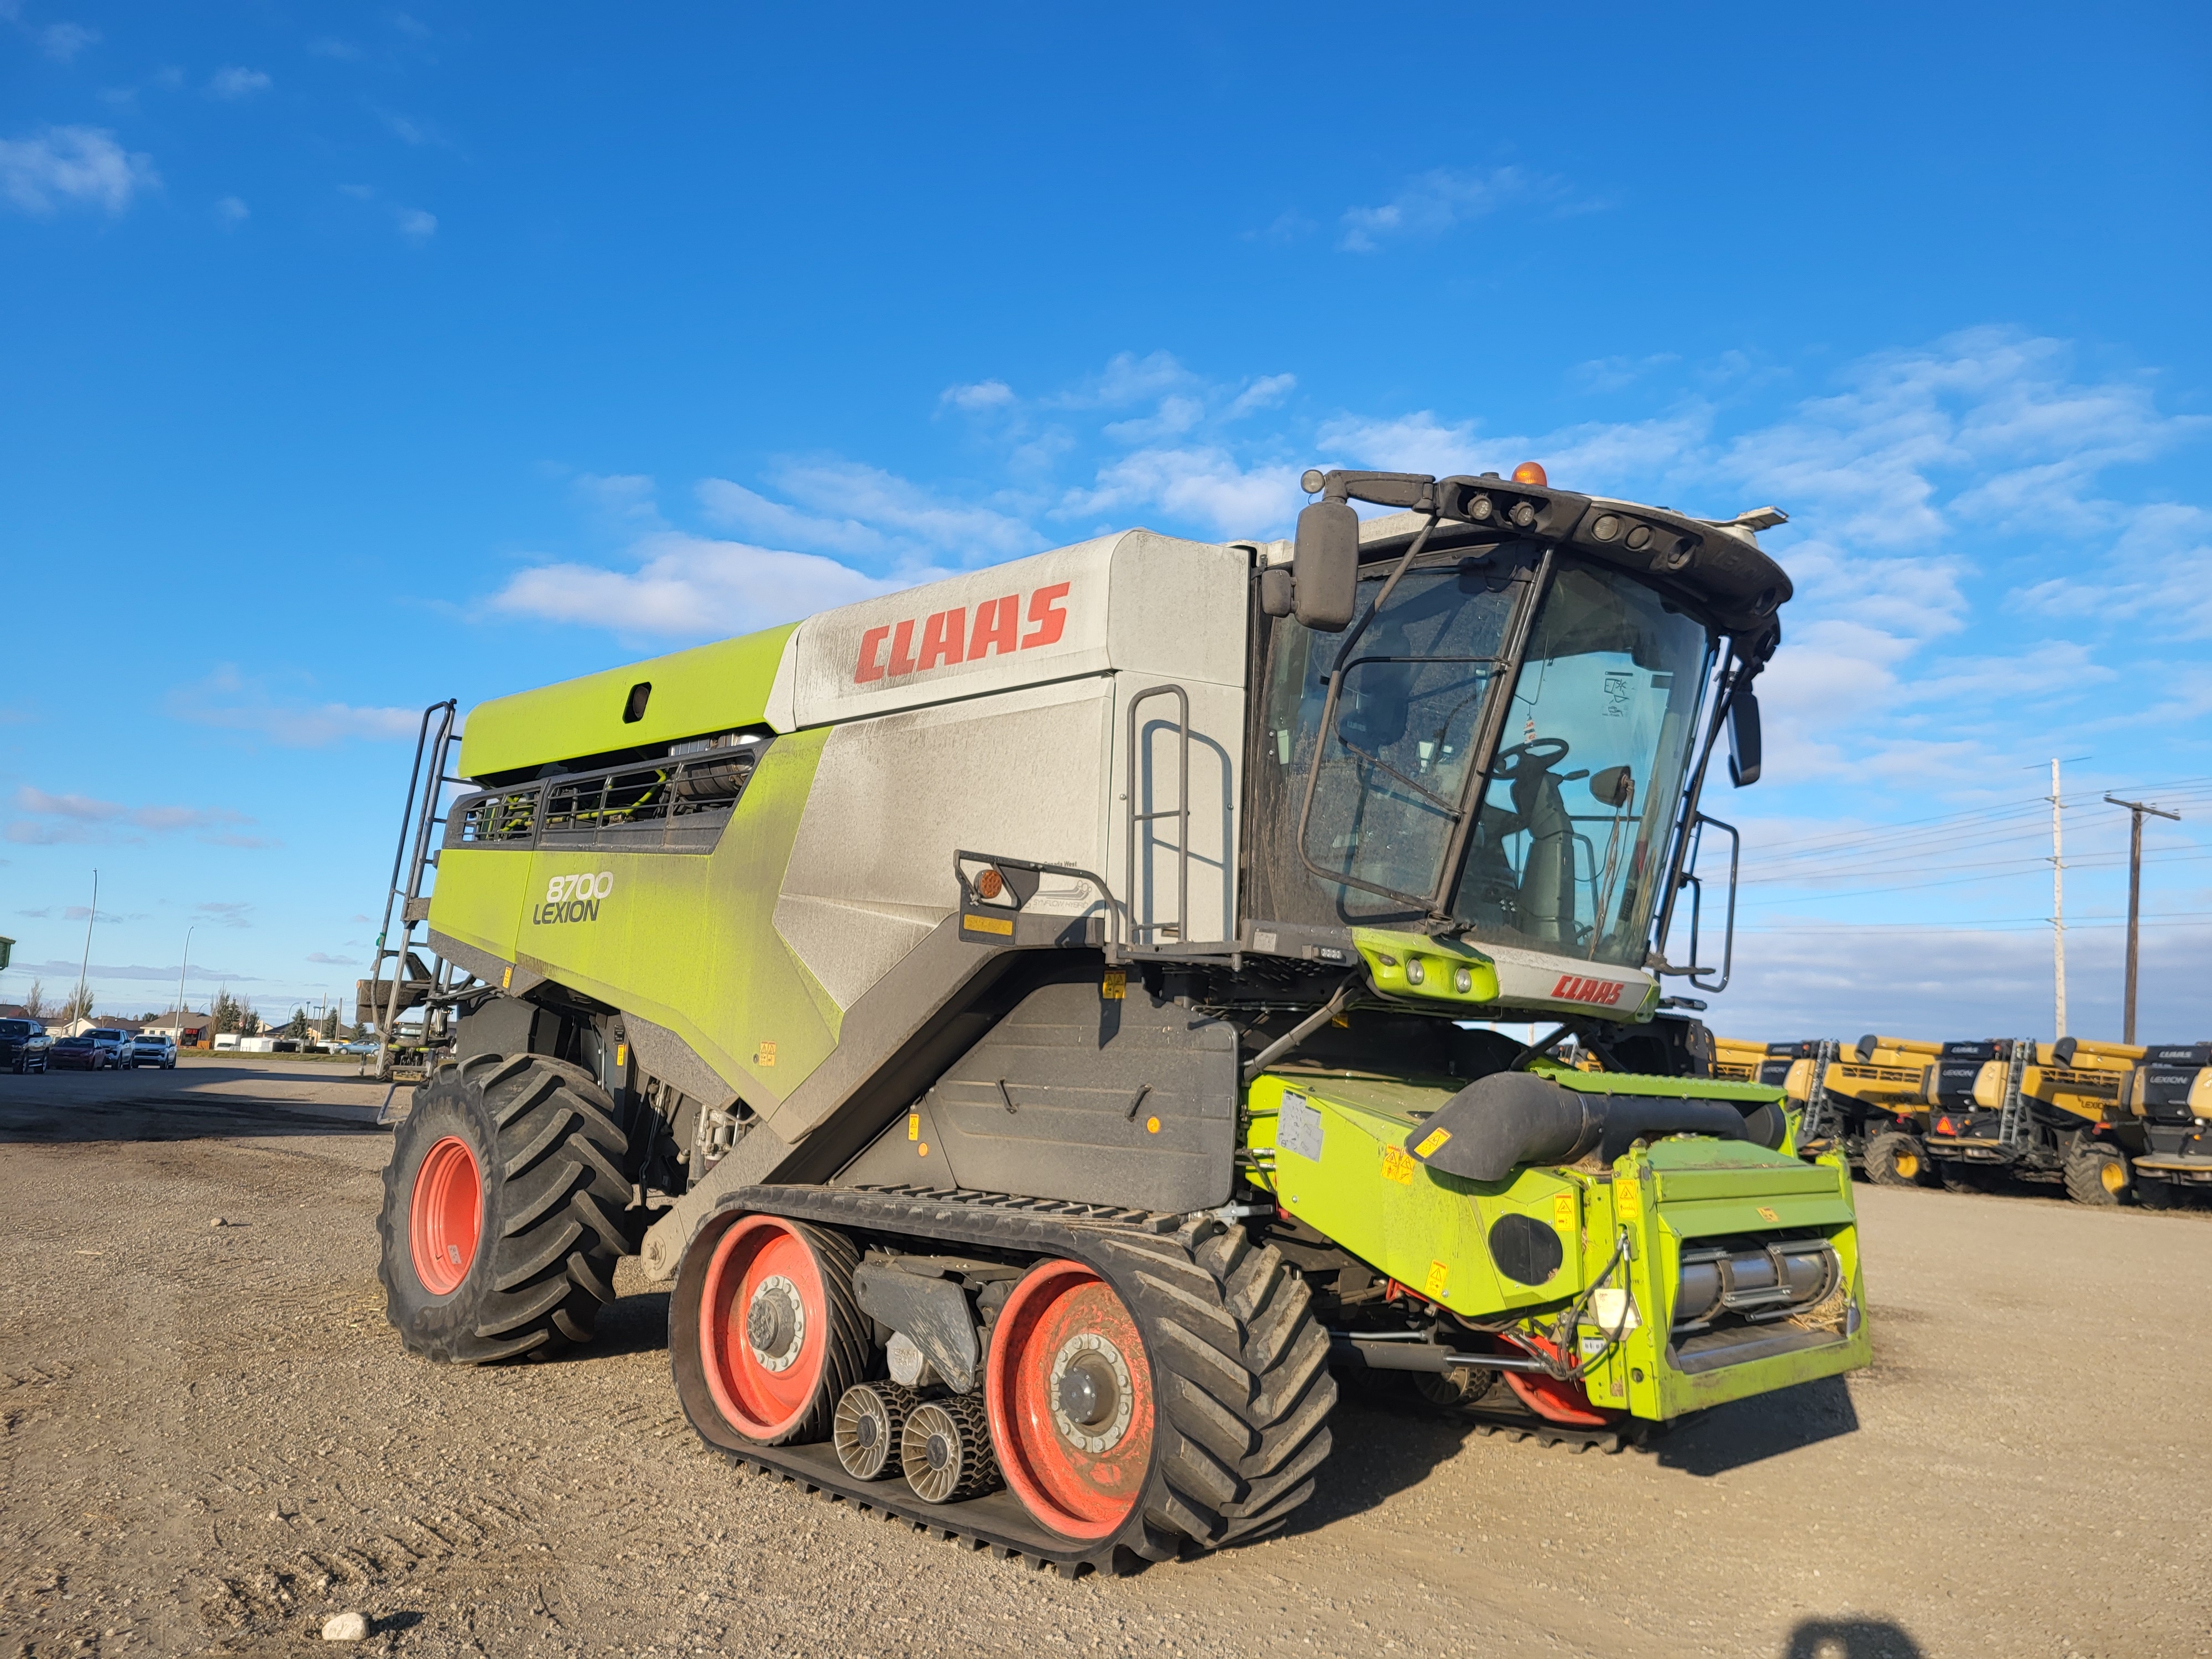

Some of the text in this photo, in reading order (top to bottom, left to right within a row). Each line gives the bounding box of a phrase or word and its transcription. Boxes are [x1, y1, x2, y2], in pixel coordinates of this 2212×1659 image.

[854, 581, 1071, 684] CLAAS
[546, 871, 613, 904] 8700
[533, 899, 601, 925] LEXION
[1551, 975, 1624, 1005] CLAAS
[1942, 1068, 1975, 1077] LEXION
[2150, 1075, 2188, 1085] LEXION
[2081, 1100, 2107, 1110] LEXIO
